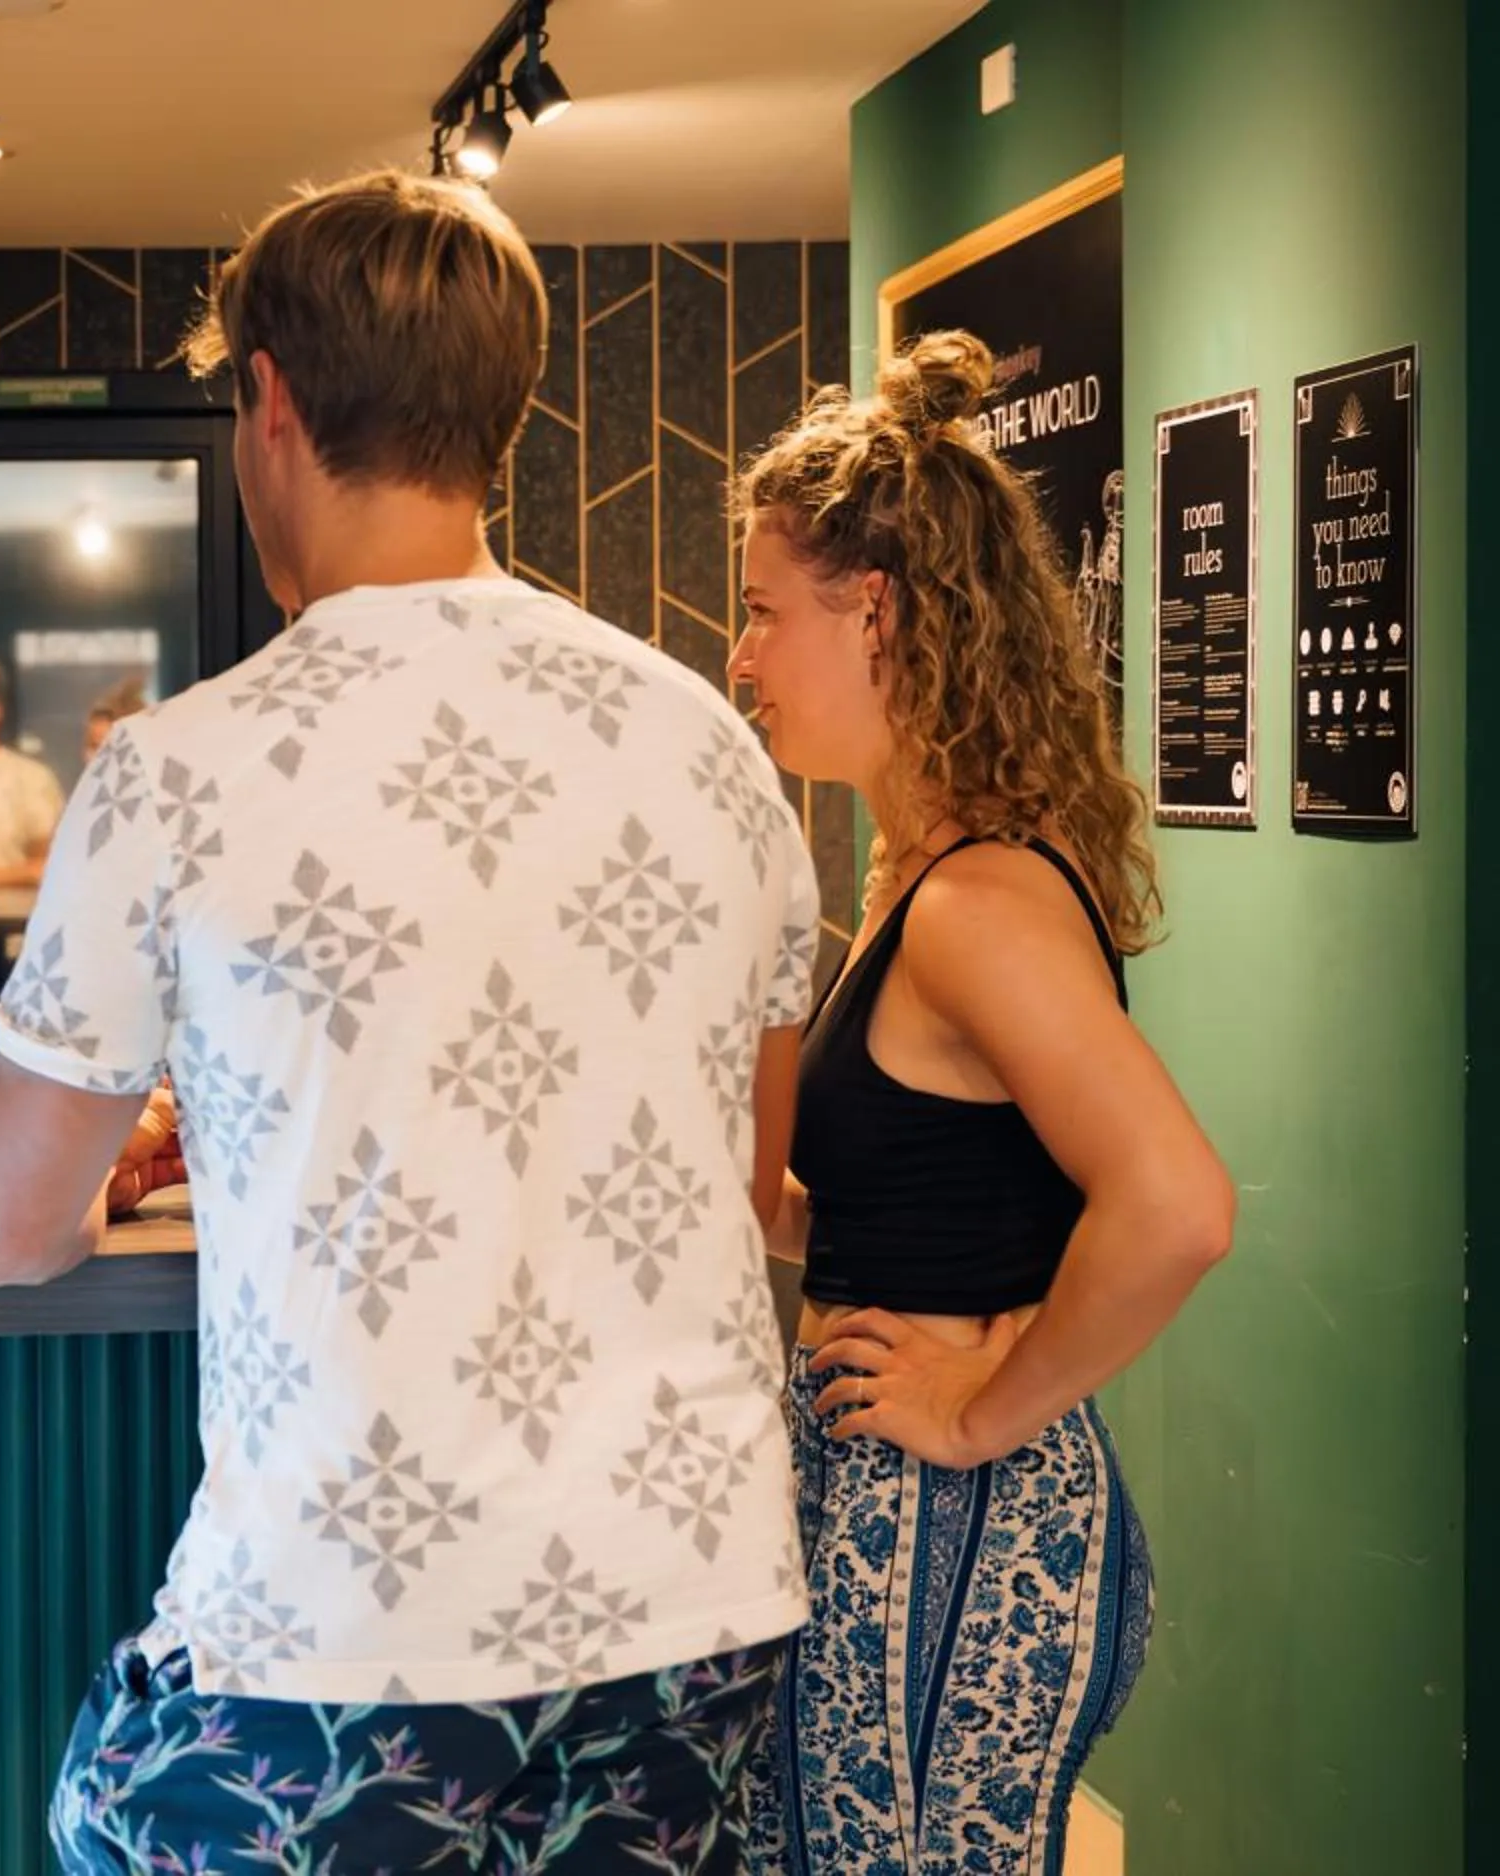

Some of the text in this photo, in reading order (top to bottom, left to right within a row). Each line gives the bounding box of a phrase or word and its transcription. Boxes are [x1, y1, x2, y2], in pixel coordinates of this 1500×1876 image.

[992, 399, 1027, 450] THE
[1029, 374, 1101, 439] WORLD
[1325, 455, 1377, 507] things
[1183, 501, 1224, 531] room
[1312, 489, 1391, 560] you need
[1183, 531, 1223, 577] rules
[1316, 543, 1386, 589] to know
